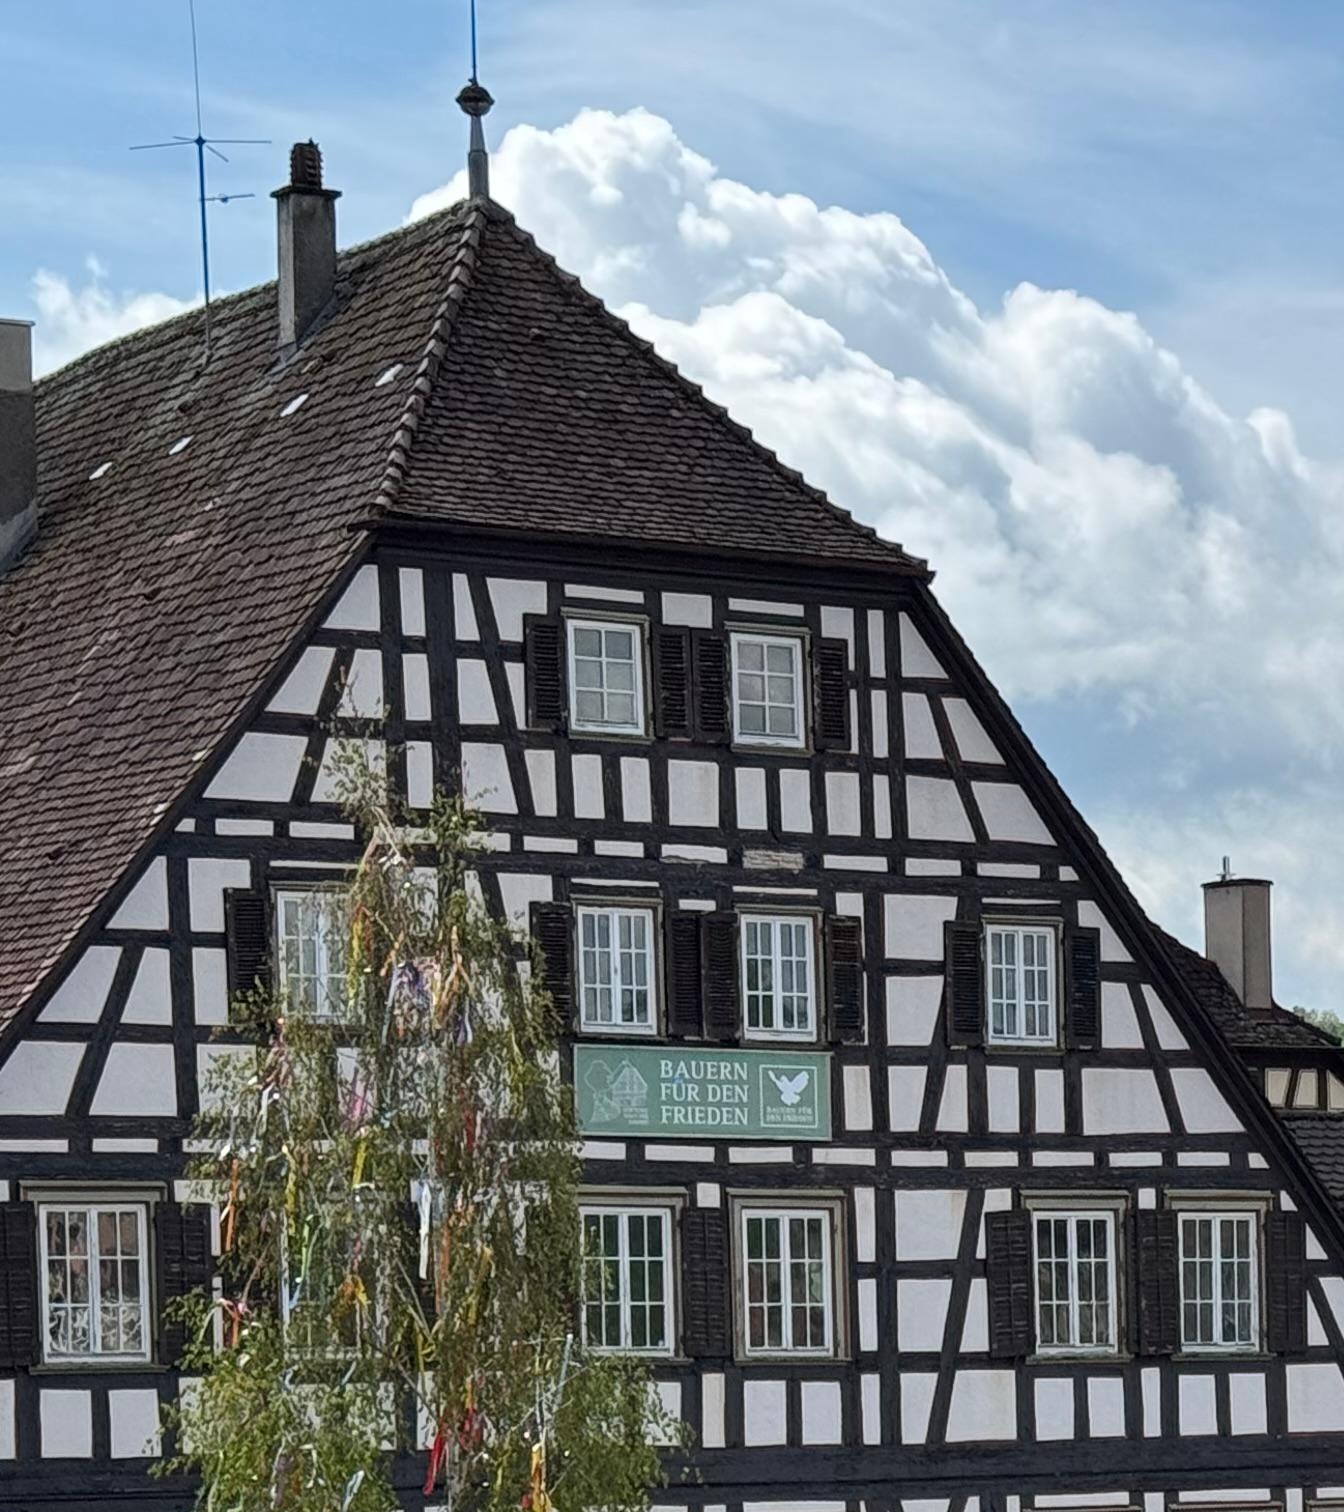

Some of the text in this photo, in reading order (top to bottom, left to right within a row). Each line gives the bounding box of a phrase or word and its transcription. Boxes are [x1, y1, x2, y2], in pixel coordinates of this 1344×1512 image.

[660, 1060, 748, 1080] BAUERN
[660, 1079, 749, 1103] FÜR DEN
[660, 1105, 749, 1126] FRIEDEN
